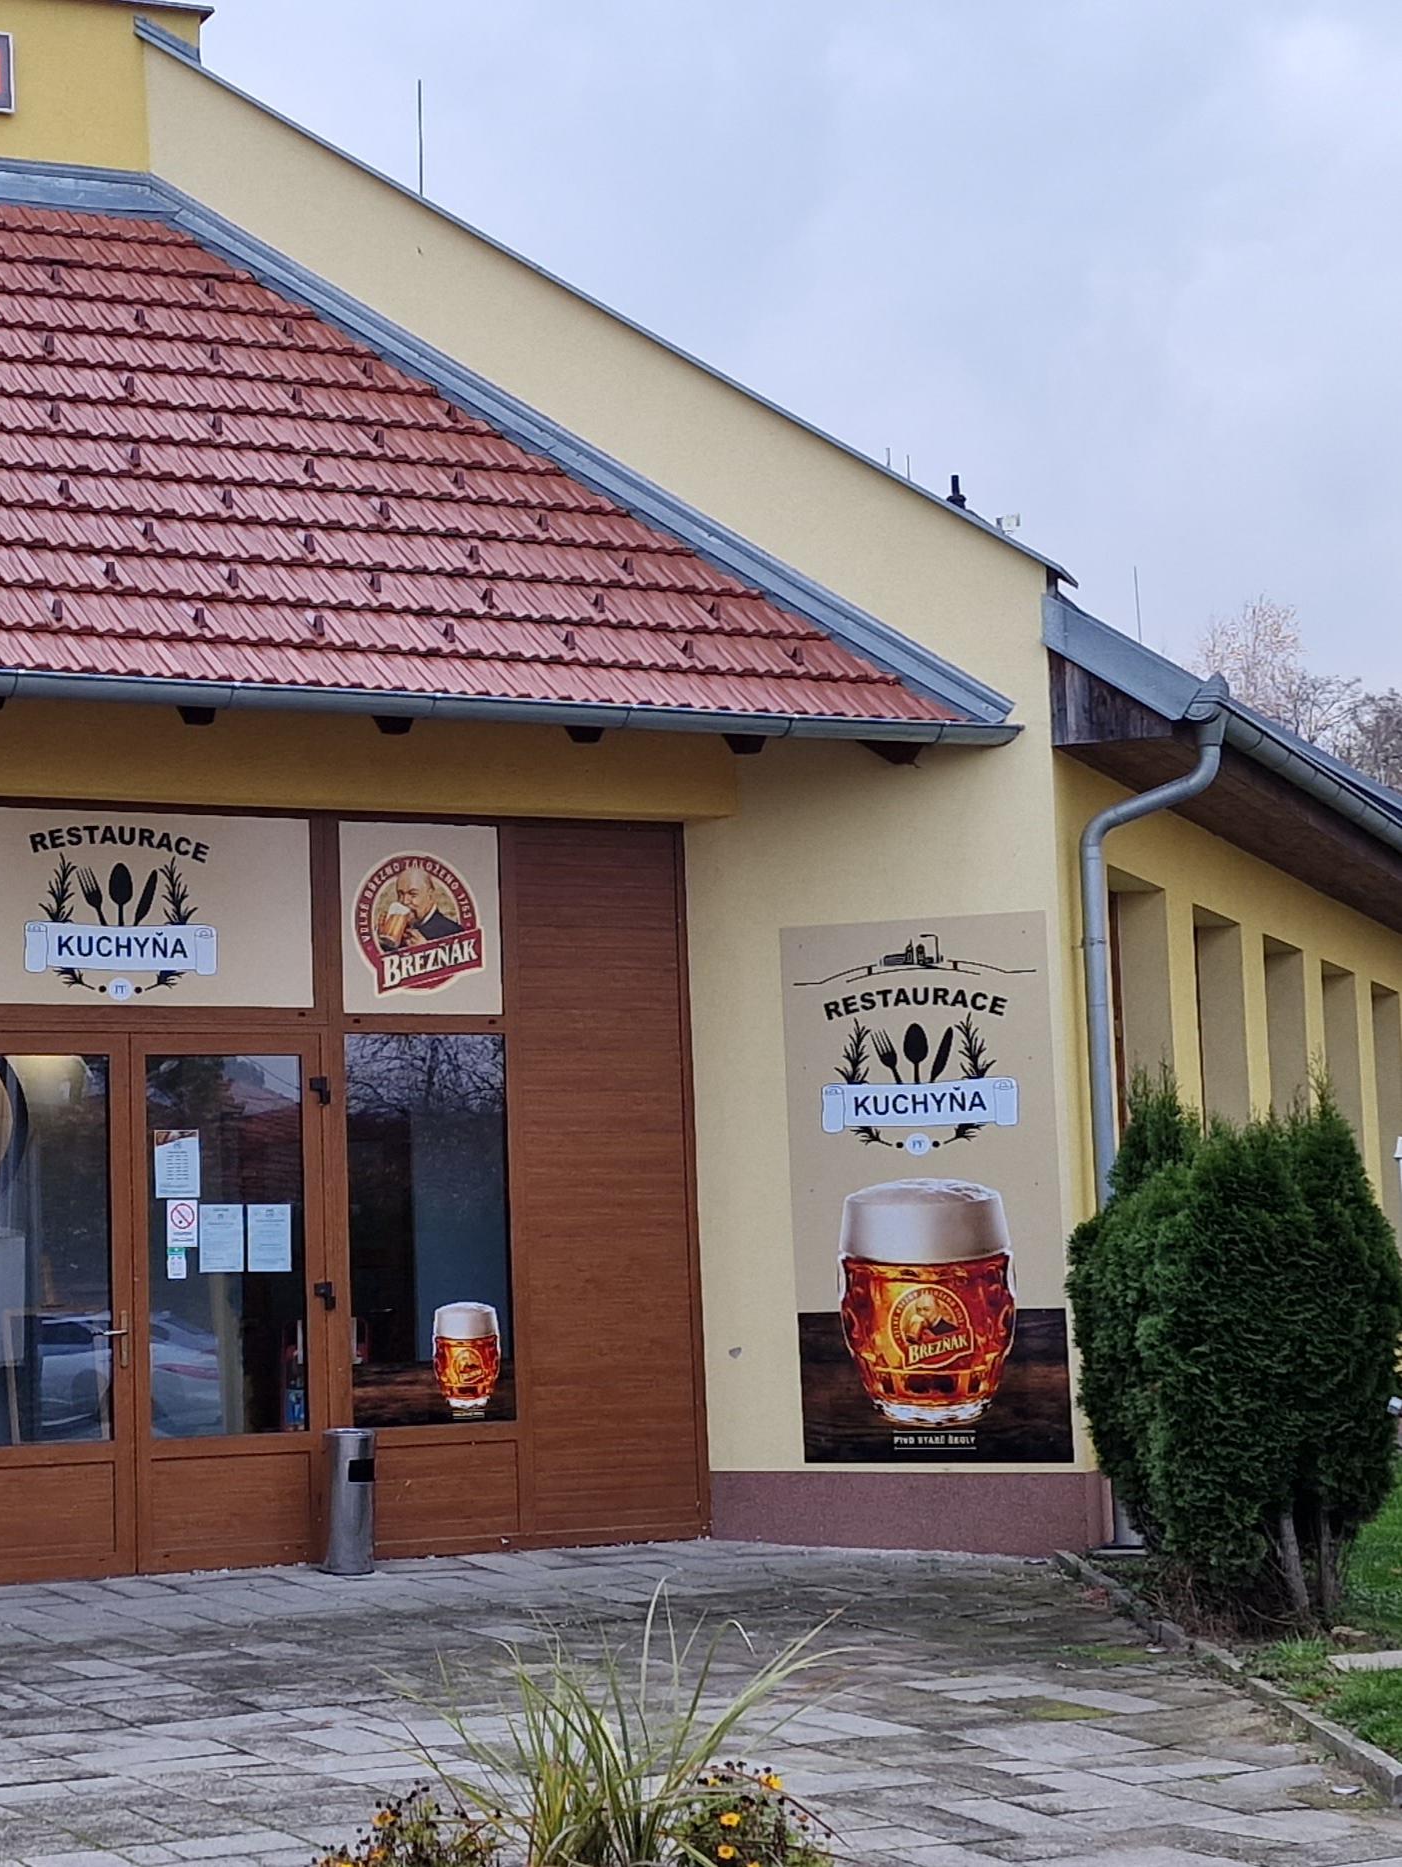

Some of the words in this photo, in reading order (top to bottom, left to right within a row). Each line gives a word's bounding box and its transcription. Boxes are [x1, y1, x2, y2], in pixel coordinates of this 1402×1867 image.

[29, 825, 210, 863] RESTAURACE
[57, 932, 188, 958] KUCHYŇA
[382, 938, 478, 988] BŘEZŇÁK
[823, 987, 1008, 1021] RESTAURACE
[854, 1086, 987, 1116] KUCHYŇA
